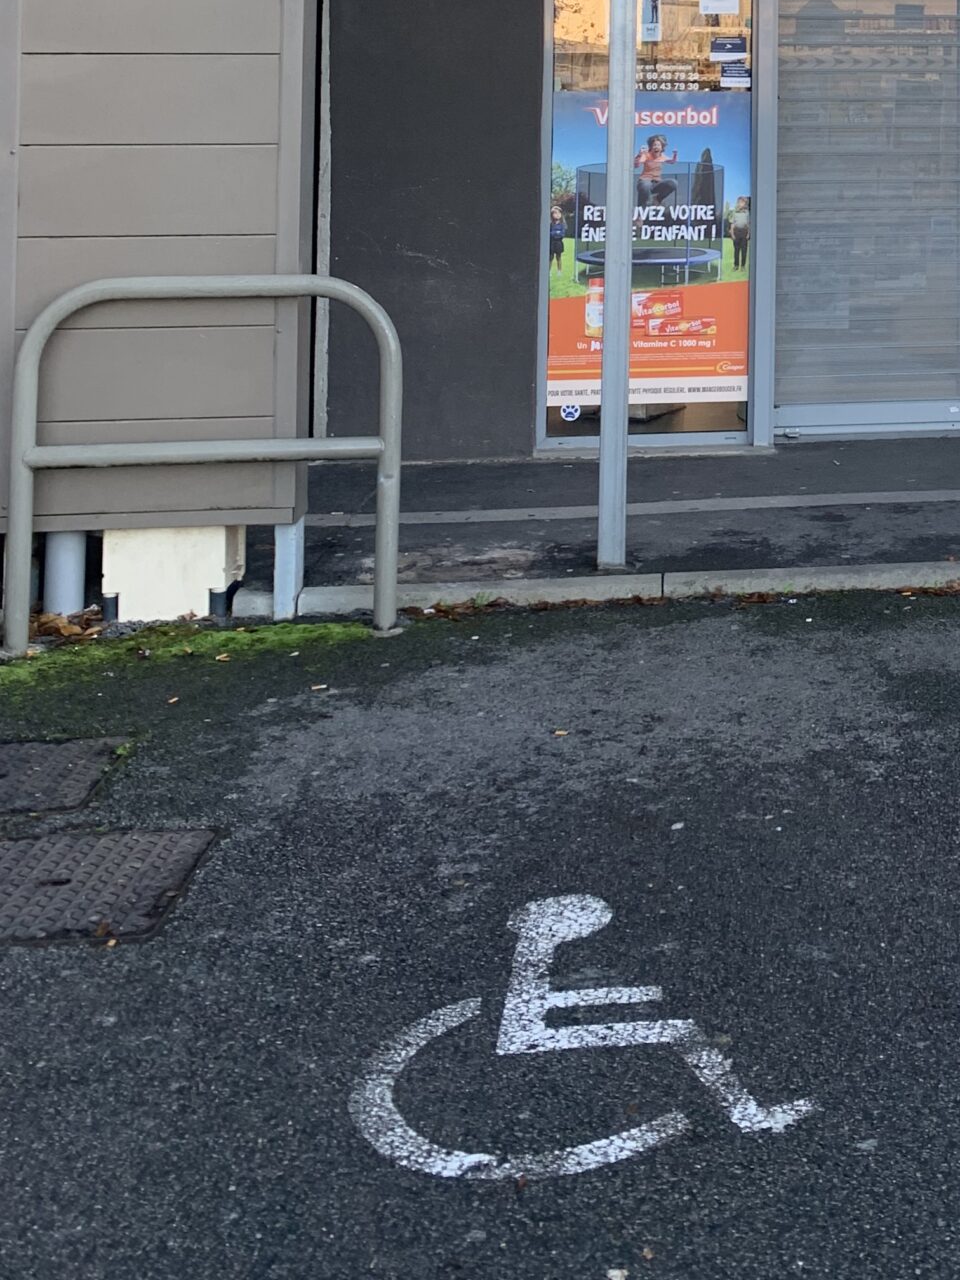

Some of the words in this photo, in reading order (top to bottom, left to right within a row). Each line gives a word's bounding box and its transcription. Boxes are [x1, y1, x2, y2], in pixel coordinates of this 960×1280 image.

[646, 82, 658, 90] 60
[660, 82, 672, 90] 43
[674, 82, 686, 90] 79
[688, 82, 699, 90] 30
[584, 205, 664, 221] RETUVEZ
[670, 205, 714, 220] VOTRE
[642, 225, 706, 241] D'ENFANT
[633, 340, 668, 348] Vitamine
[670, 340, 676, 348] C
[679, 340, 696, 348] 1000
[698, 340, 710, 348] mg
